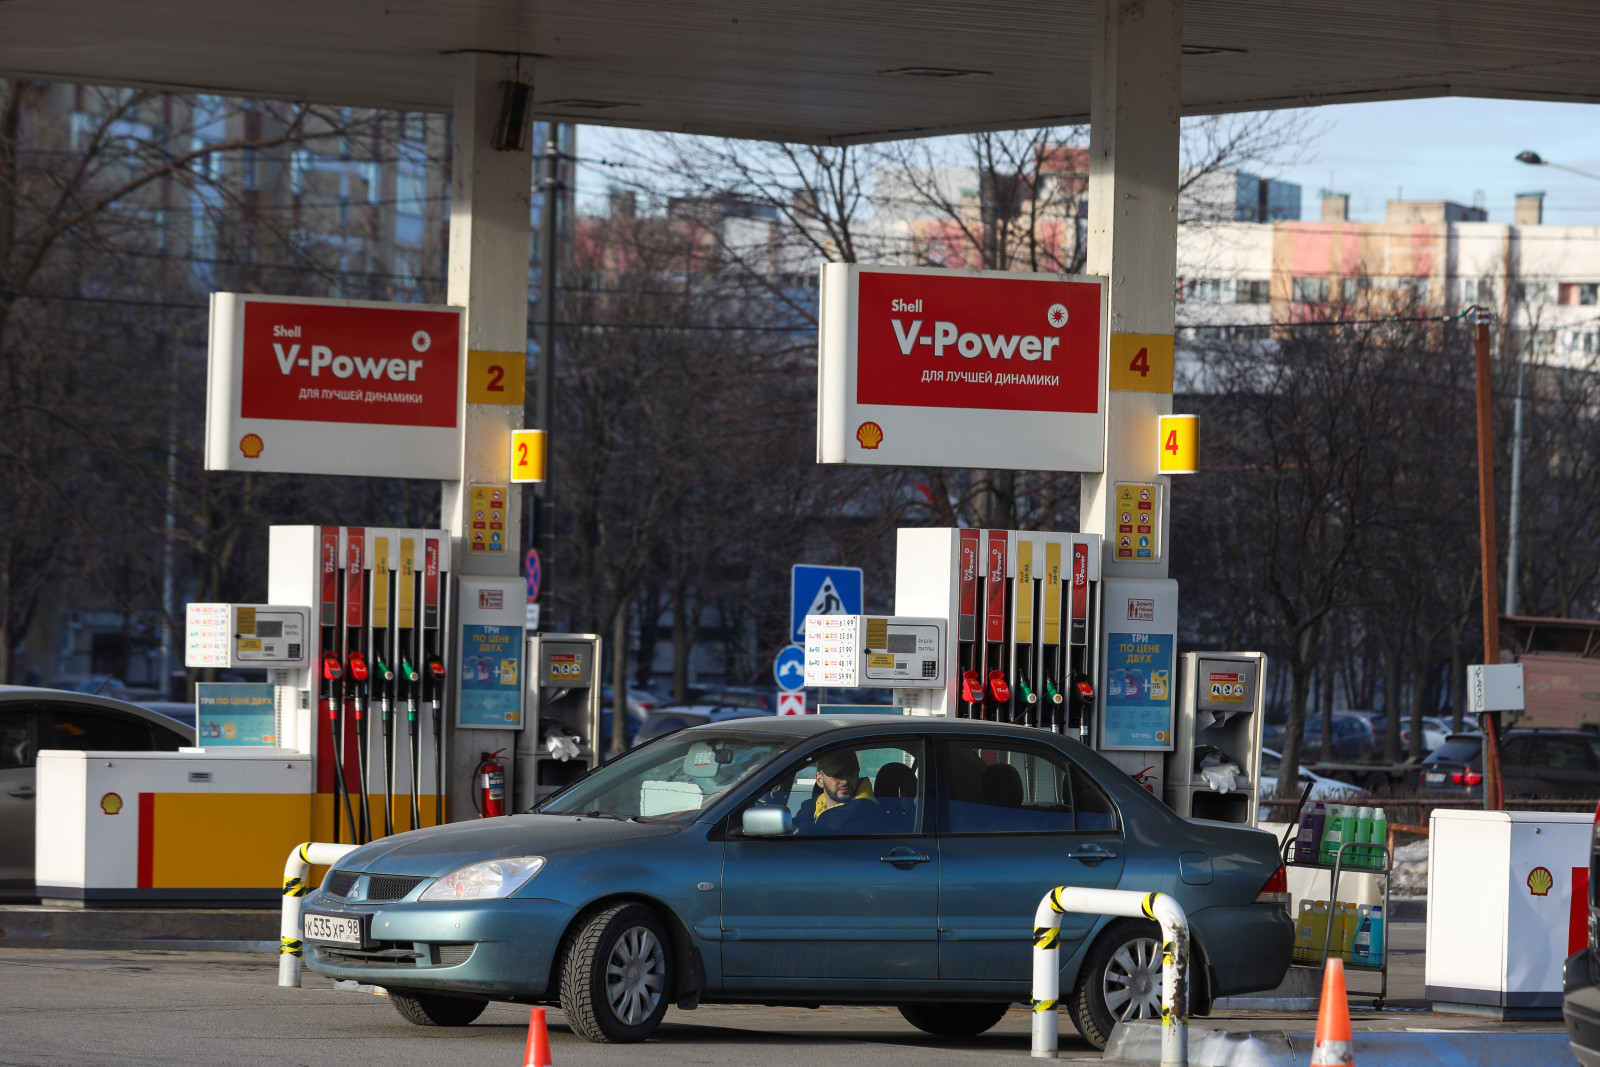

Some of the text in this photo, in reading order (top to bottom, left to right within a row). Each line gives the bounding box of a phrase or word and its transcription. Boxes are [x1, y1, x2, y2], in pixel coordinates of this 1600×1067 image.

[891, 299, 923, 313] Shell
[273, 325, 302, 339] Shell
[891, 318, 1060, 362] V-Power
[272, 342, 424, 382] V-Power
[1129, 347, 1150, 378] 4
[486, 365, 505, 392] 2
[921, 369, 1060, 387] ДЛЯ ЛУЧШЕЙ ДИНАМИКИ
[298, 388, 424, 404] ДЛЯ ЛУЧШЕЙ ДИНАМИКИ
[1164, 430, 1179, 456] 4
[518, 442, 528, 466] 2
[483, 626, 500, 634] ТРИ
[1132, 633, 1148, 642] ТРИ
[472, 634, 510, 644] ПО ЦЕНЕ
[478, 644, 503, 652] ДВУХ
[1120, 644, 1160, 654] ПО ЦЕНЕ
[1126, 655, 1152, 664] ДВУХ
